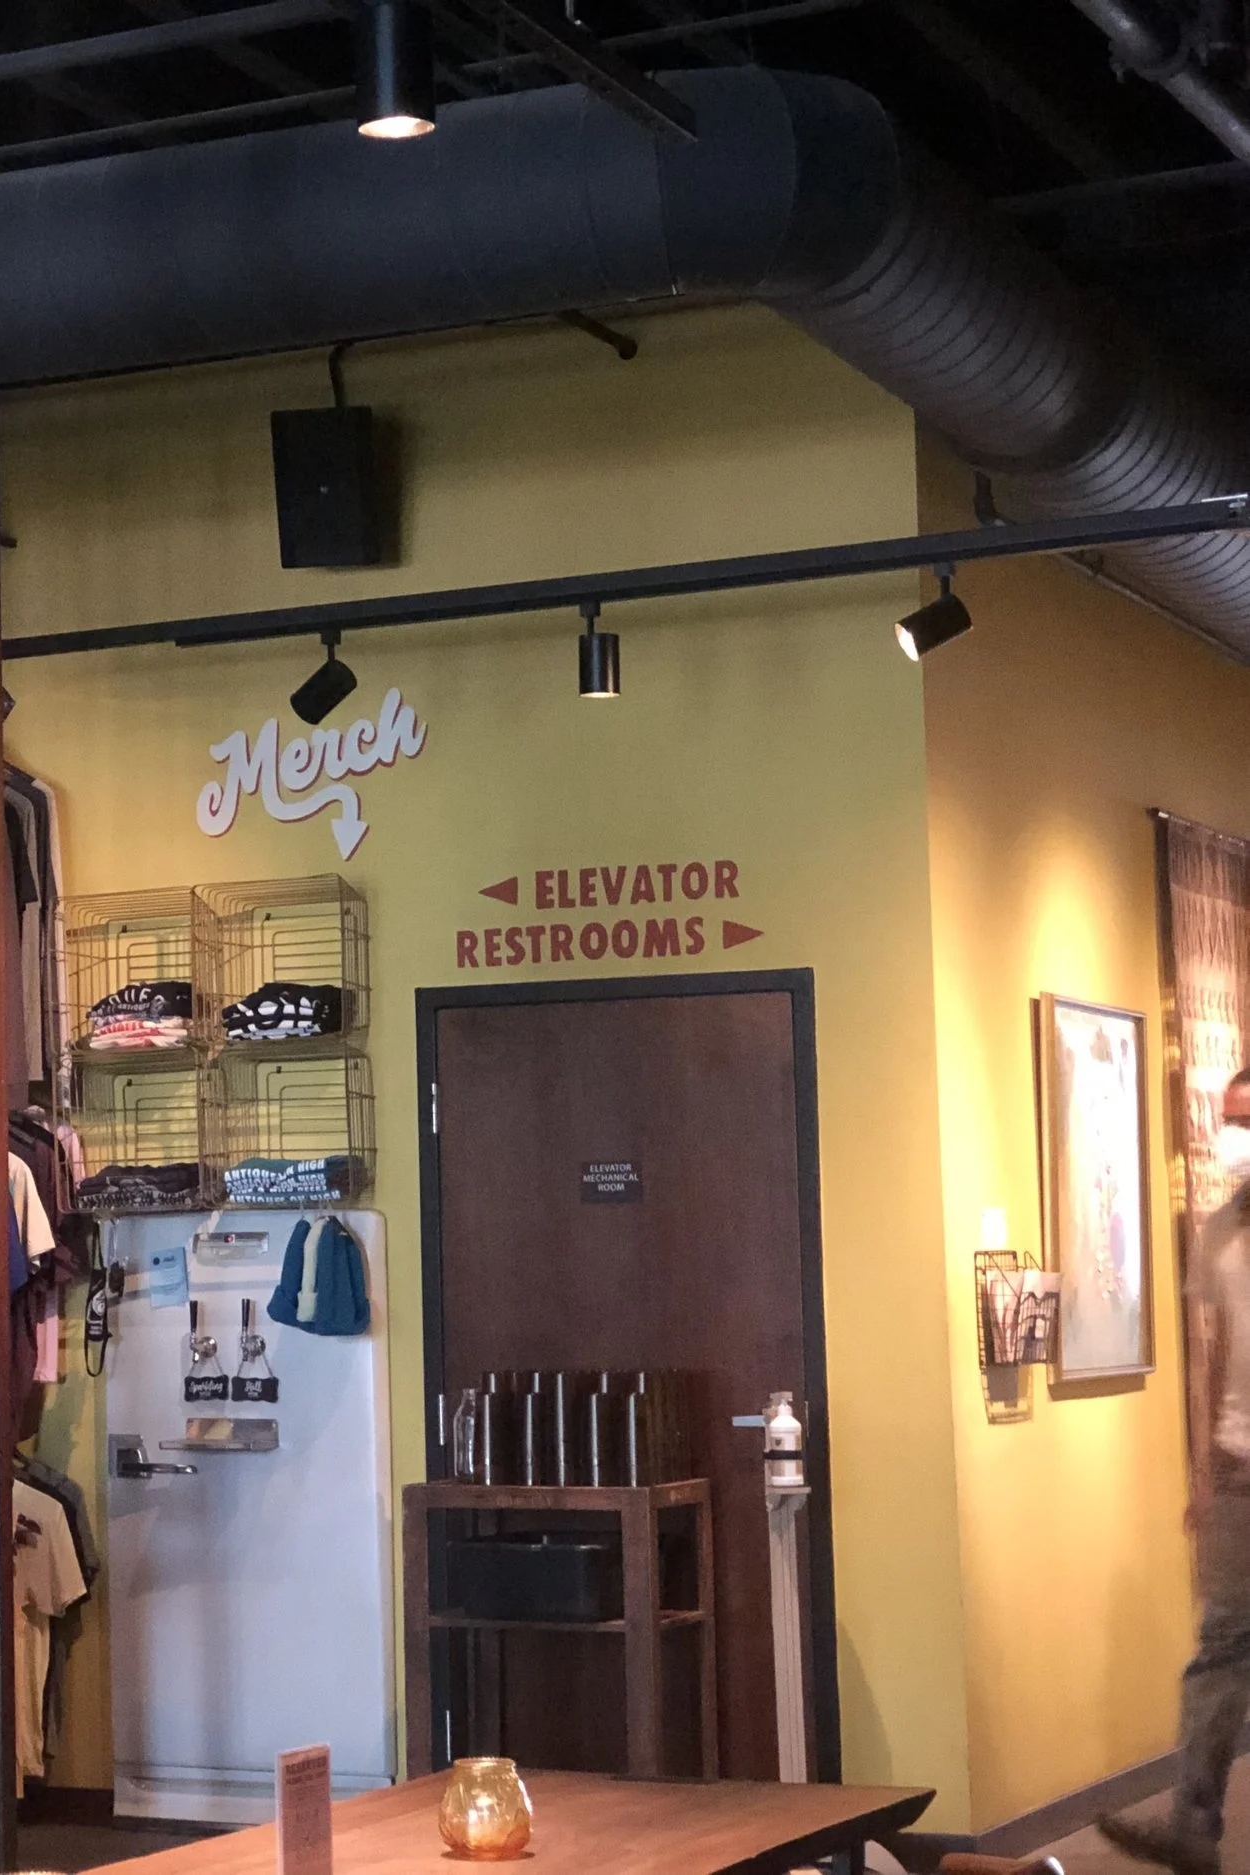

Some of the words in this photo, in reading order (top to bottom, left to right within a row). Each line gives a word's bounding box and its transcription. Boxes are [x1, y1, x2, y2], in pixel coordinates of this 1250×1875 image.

[196, 687, 428, 838] Merch
[535, 860, 740, 909] ELEVATOR
[456, 916, 706, 968] RESTROOMS
[298, 1159, 325, 1172] HIGH
[590, 1163, 632, 1173] ELEVATOR
[583, 1173, 639, 1183] MECHANICAL
[598, 1183, 625, 1192] ROOM
